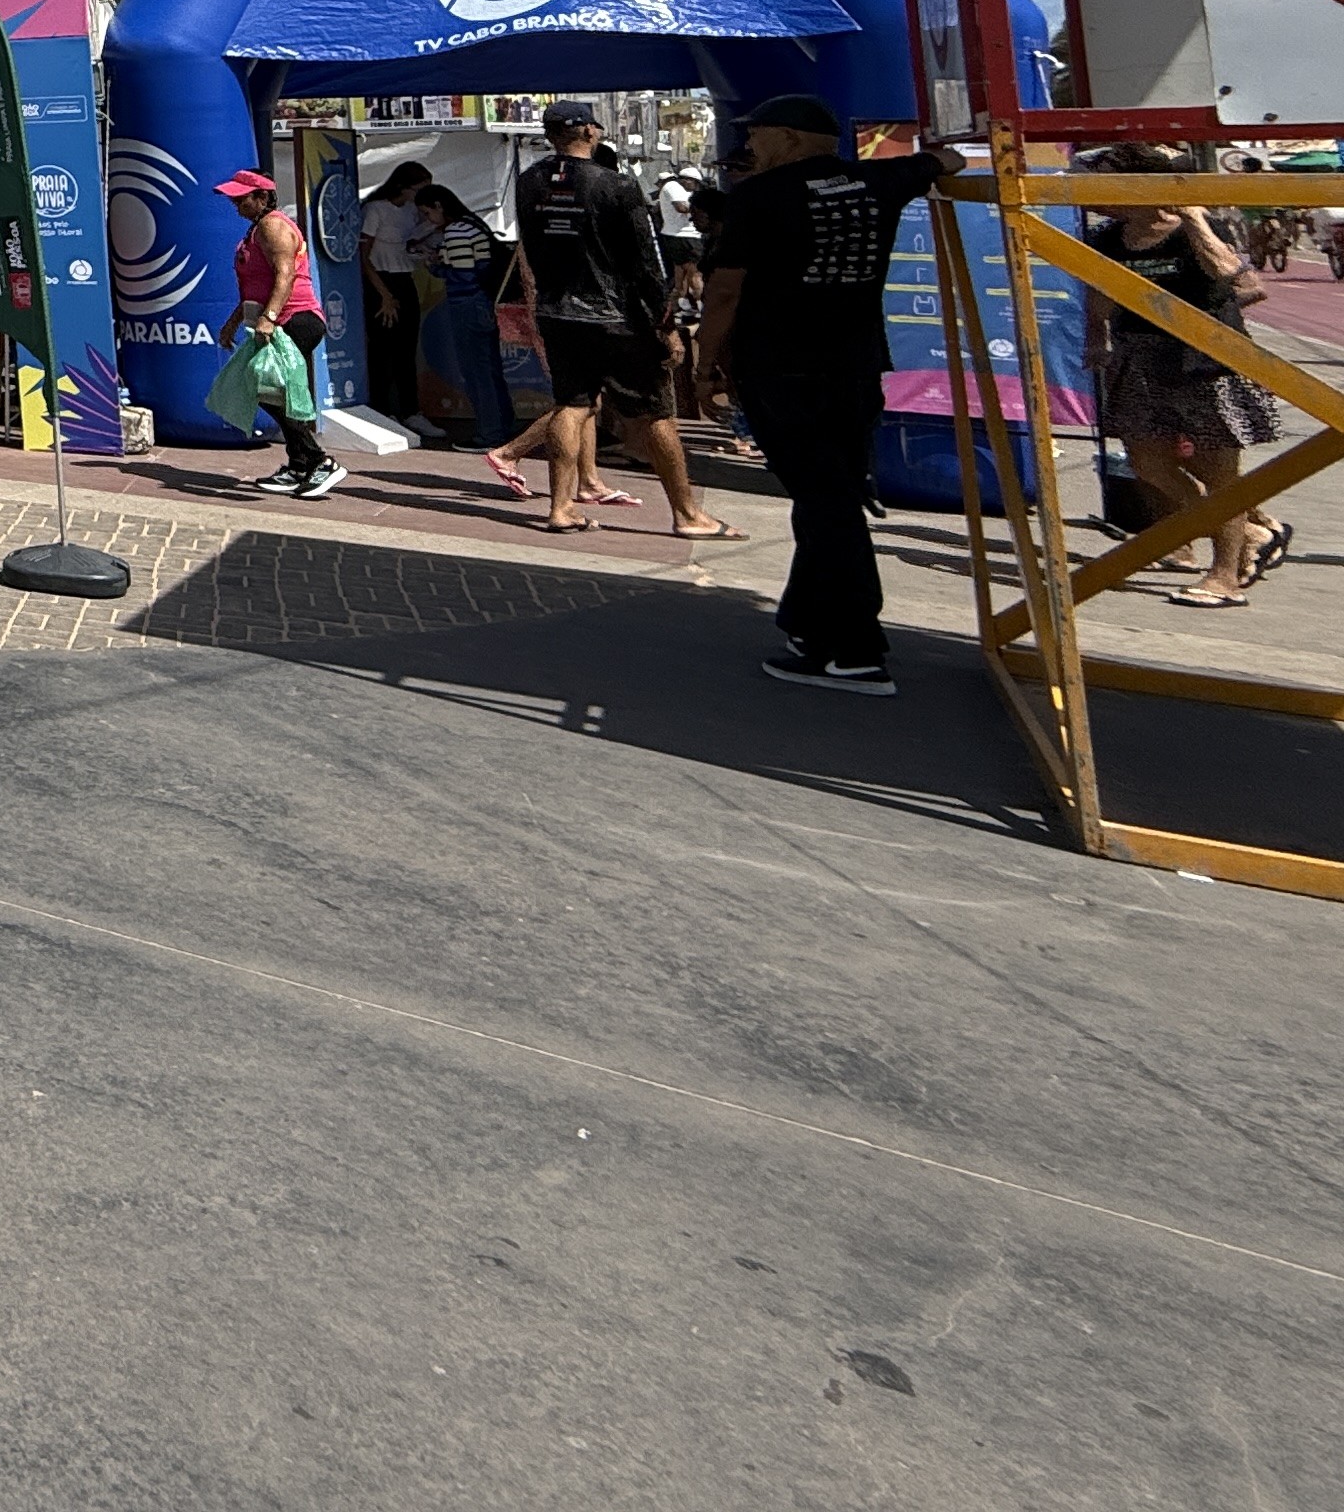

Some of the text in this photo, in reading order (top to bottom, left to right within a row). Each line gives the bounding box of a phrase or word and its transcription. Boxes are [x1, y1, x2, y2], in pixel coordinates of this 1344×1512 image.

[414, 9, 613, 53] TV CABO BRANCO
[32, 175, 68, 191] PRAIA
[36, 191, 65, 208] VIVA
[119, 316, 215, 345] PARAÍBA
